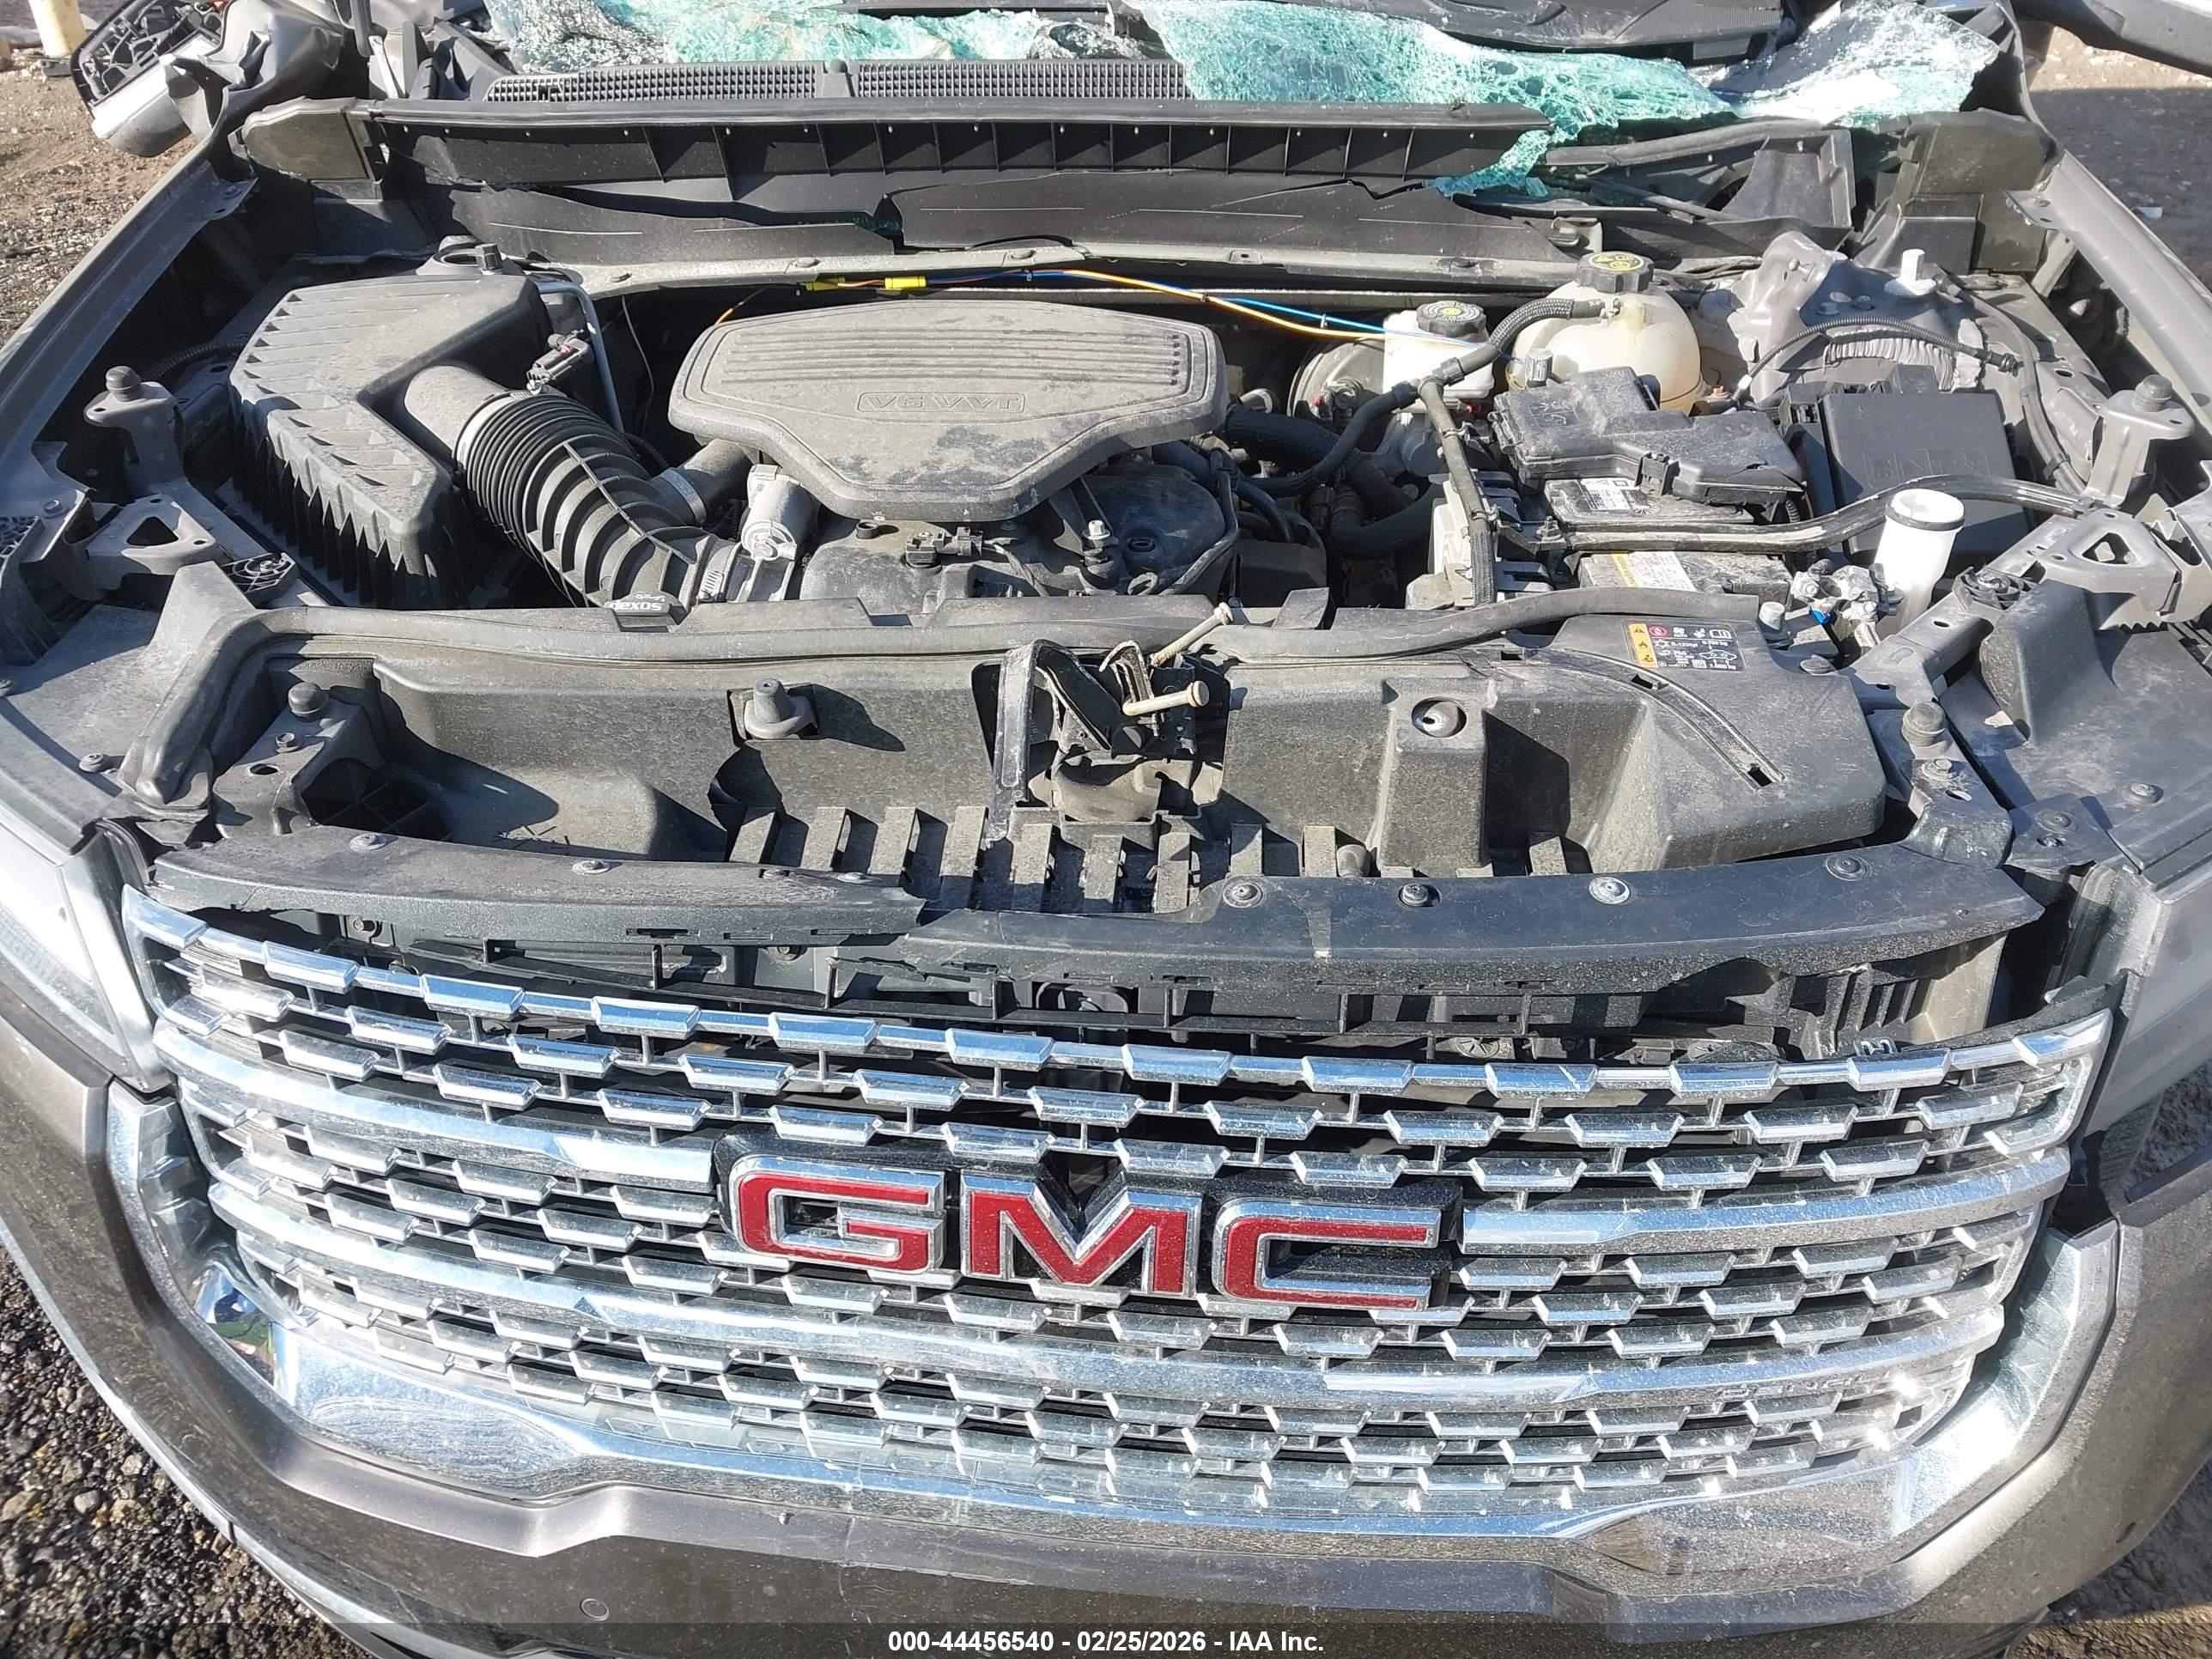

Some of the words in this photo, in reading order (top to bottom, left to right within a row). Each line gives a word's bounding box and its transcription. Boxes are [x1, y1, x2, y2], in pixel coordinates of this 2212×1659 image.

[865, 395, 924, 410] V6
[932, 396, 1019, 410] VVT
[607, 599, 662, 611] dexos
[729, 1154, 1443, 1312] GMC
